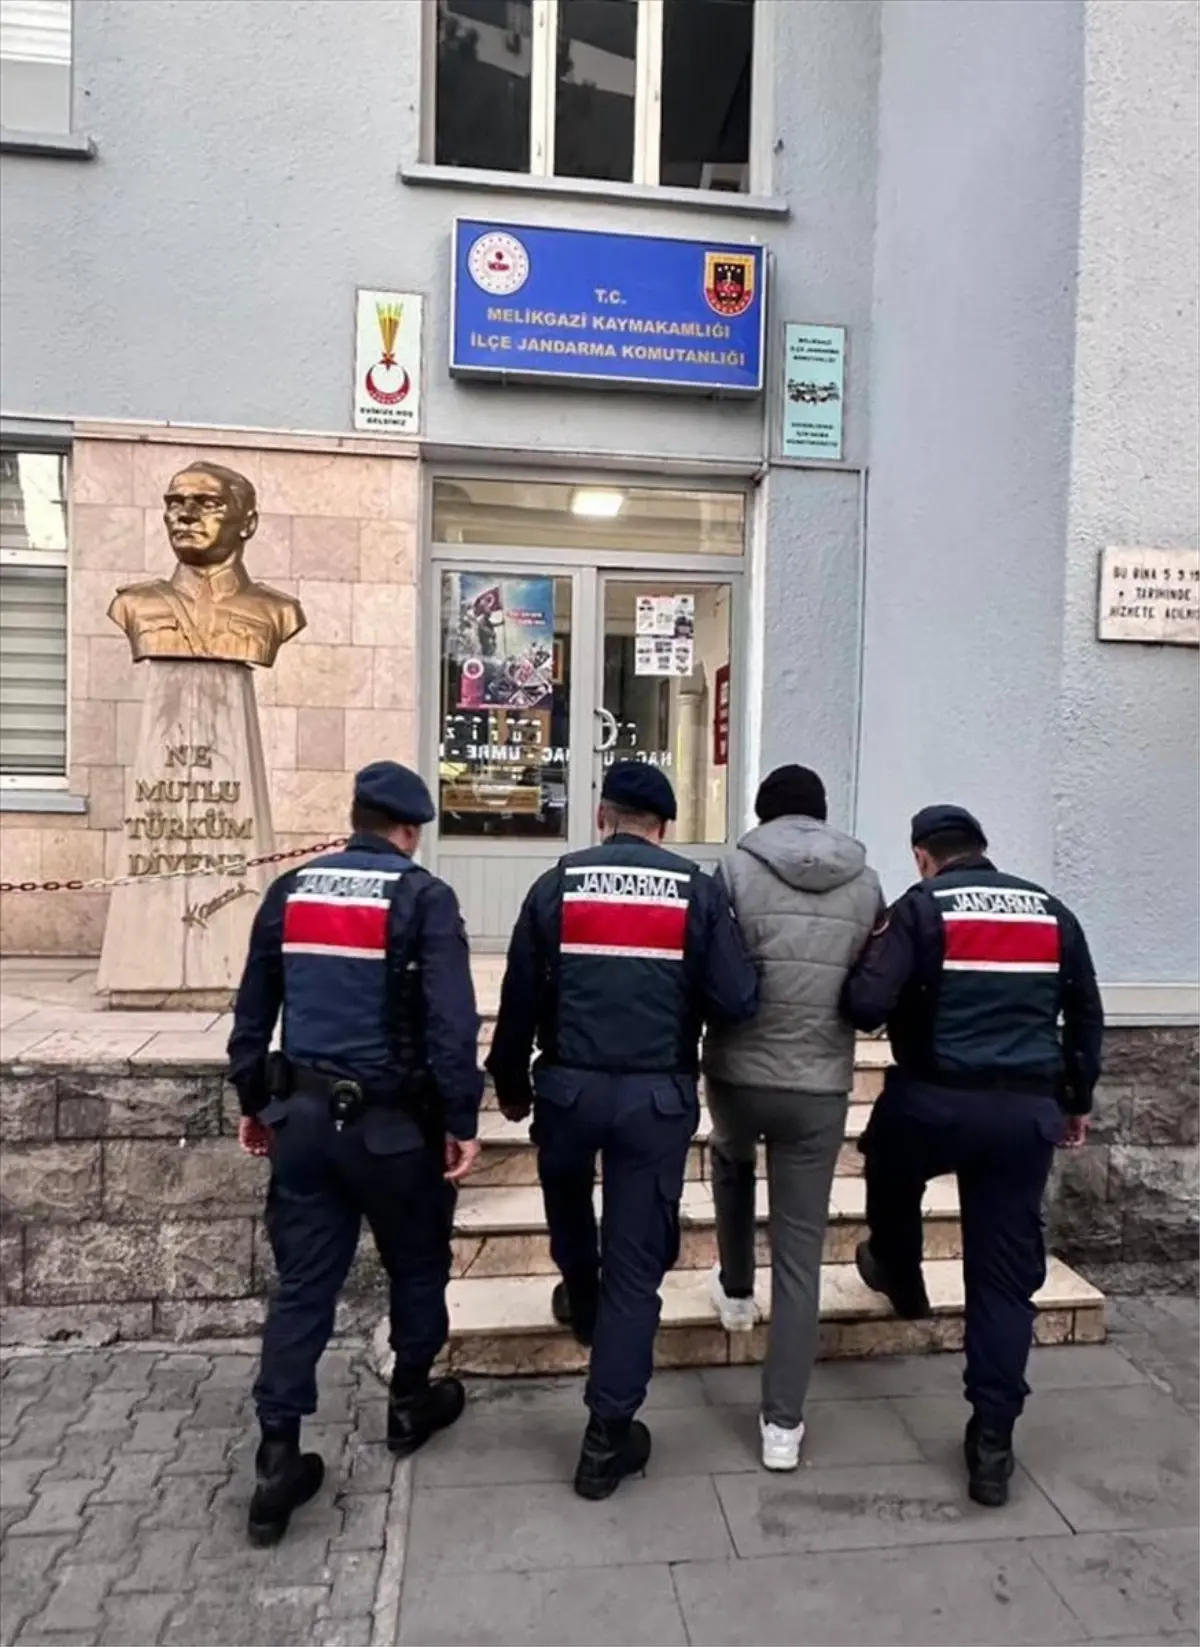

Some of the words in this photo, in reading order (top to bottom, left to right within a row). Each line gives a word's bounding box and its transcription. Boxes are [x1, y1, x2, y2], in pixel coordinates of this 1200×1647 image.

[594, 288, 628, 305] T.C.
[486, 306, 587, 329] MELİKGAZİ
[592, 315, 731, 339] KAYMAKAMLIĞI
[470, 329, 513, 352] İLÇE
[516, 337, 618, 358] JANDARMA
[621, 344, 746, 367] KOMUTANLIĞI
[163, 744, 213, 769] NE
[135, 779, 241, 804] MUTLU
[124, 807, 254, 841] TÜRKÜM
[295, 874, 385, 899] JANDARMA
[577, 872, 679, 899] JANDARMA
[952, 891, 1048, 915] JANDARMA
